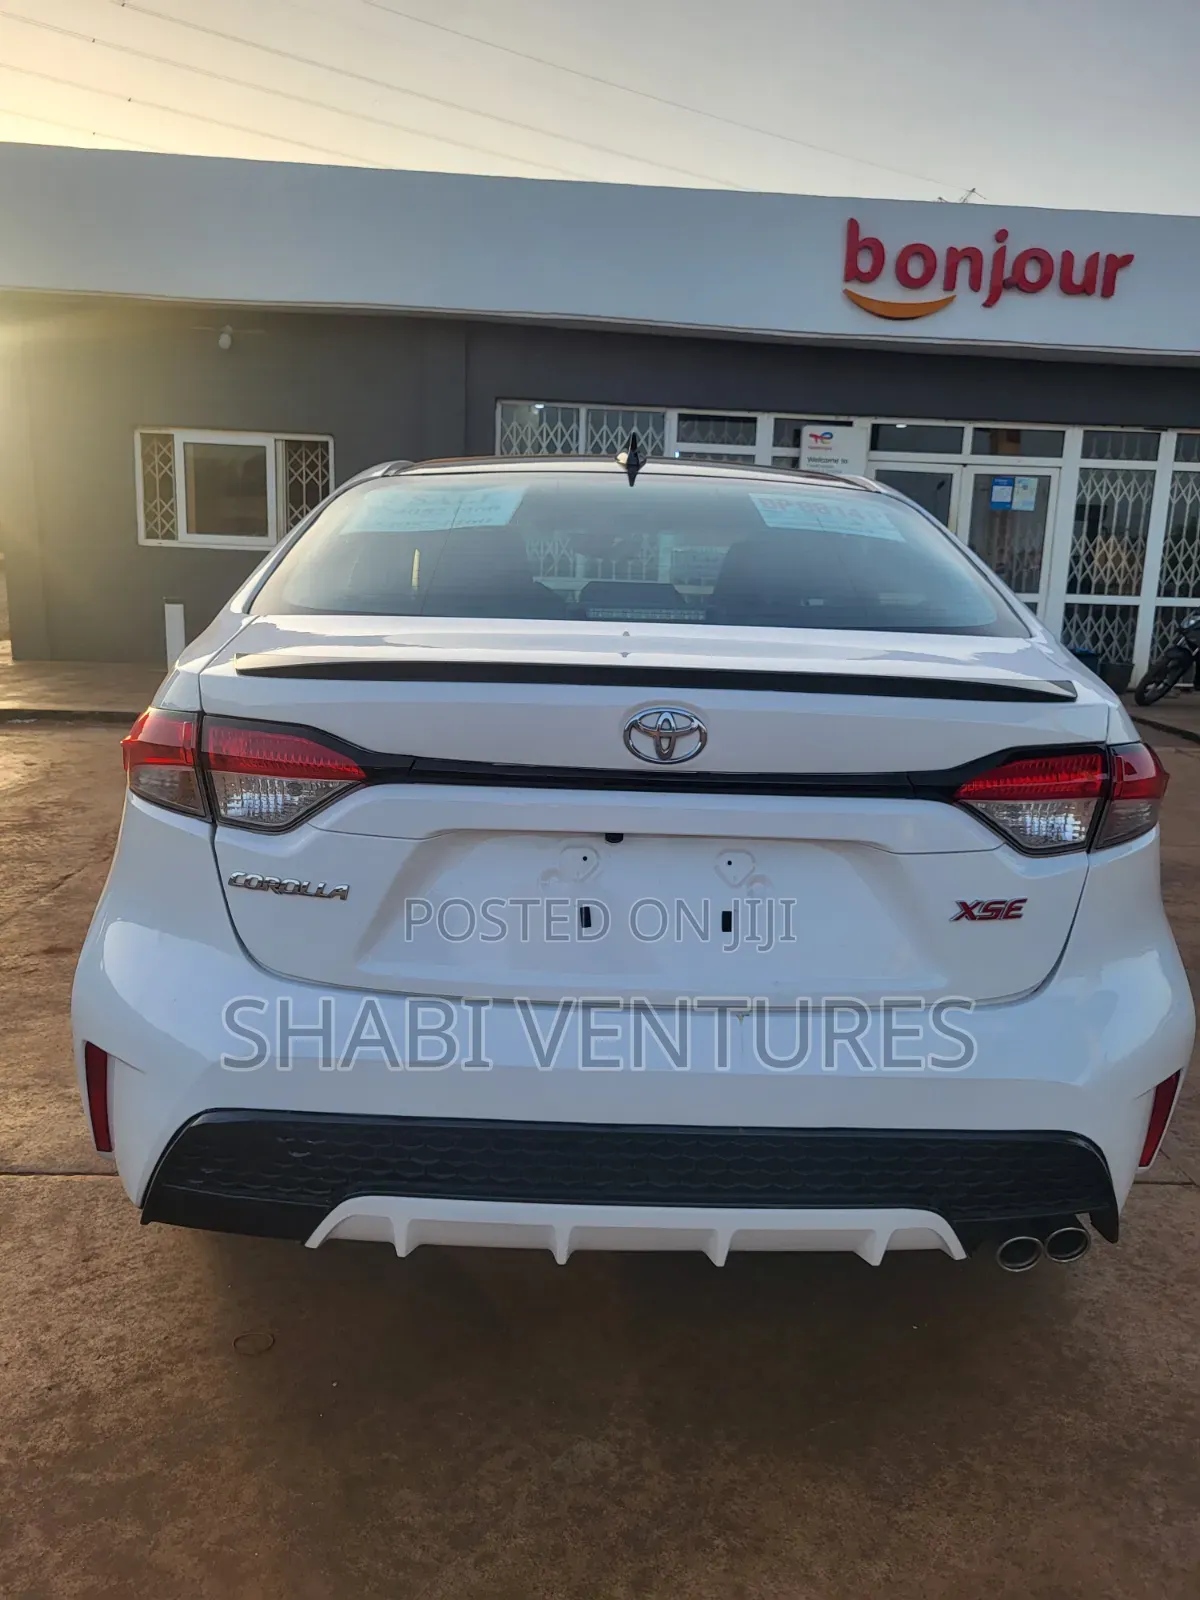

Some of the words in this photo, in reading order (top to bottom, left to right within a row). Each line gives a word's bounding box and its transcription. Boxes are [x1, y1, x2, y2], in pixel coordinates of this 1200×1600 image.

[843, 217, 1134, 308] bonjour
[228, 871, 350, 901] COROLLA
[948, 897, 1028, 921] XSE
